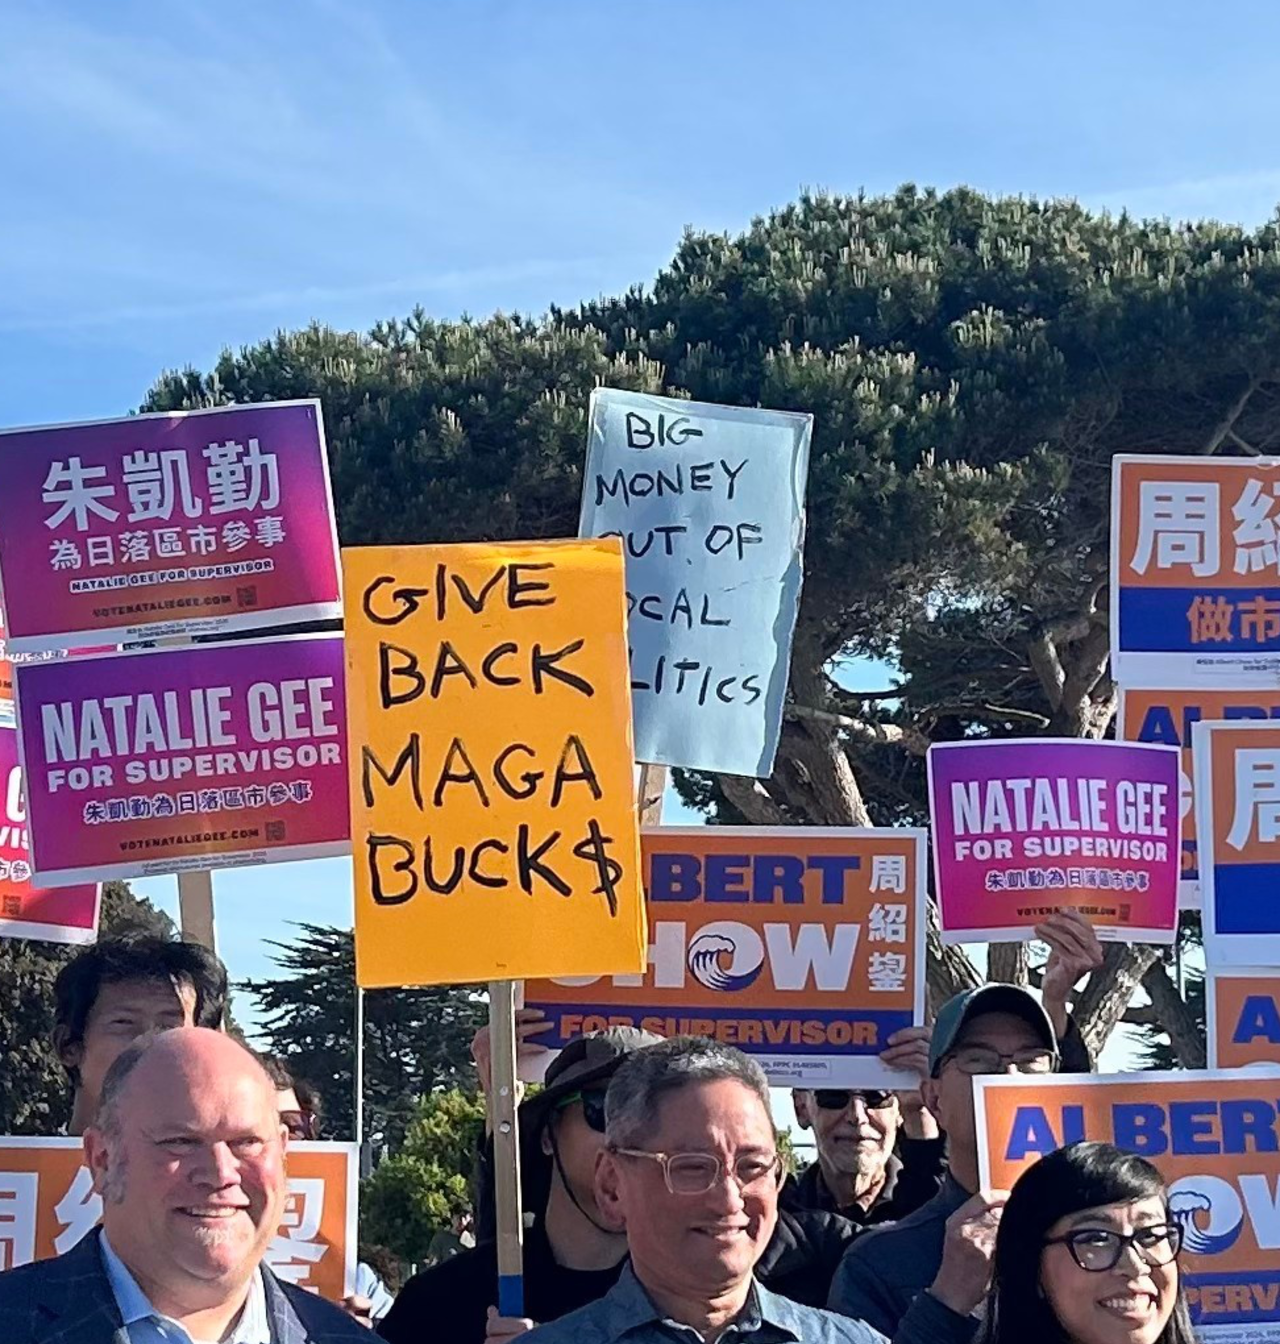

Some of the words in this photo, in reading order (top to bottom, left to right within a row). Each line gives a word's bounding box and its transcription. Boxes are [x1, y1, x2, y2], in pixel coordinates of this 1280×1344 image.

[626, 411, 704, 451] BIG
[41, 437, 280, 532] 朱凱勤
[594, 458, 750, 508] MONEY
[49, 515, 287, 571] 為日落區市參事
[598, 525, 687, 558] UT
[705, 523, 764, 560] OF
[71, 576, 126, 591] NATALIE
[363, 562, 557, 627] GIVE
[377, 638, 595, 710] BACK
[42, 685, 237, 764] NATALIE
[248, 676, 340, 743] GEE
[47, 763, 114, 794] FOR
[125, 744, 342, 785] SUPERVISOR
[361, 733, 603, 810] MAGA
[950, 777, 1110, 836] NATALIE
[1115, 780, 1168, 838] GEE
[366, 818, 624, 918] BUCK$
[954, 839, 1014, 862] FOR
[1023, 837, 1168, 863] SUPERVISOR
[548, 920, 862, 992] HOW
